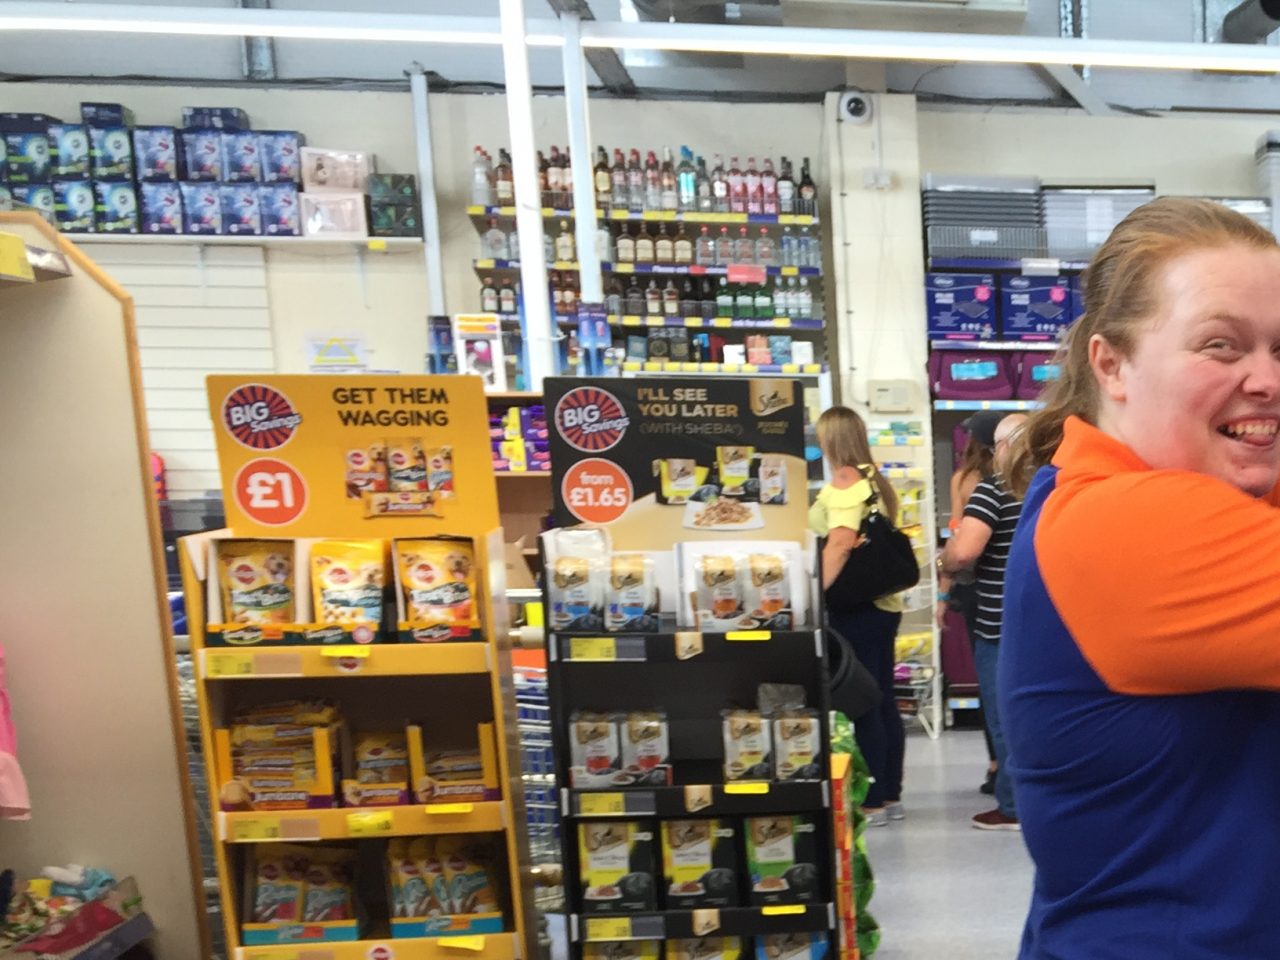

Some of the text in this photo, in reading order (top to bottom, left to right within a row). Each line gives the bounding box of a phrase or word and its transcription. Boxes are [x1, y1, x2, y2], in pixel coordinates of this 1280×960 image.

[332, 388, 448, 405] GET THEM
[638, 388, 707, 401] I'LL SEE
[230, 402, 269, 425] BIG
[338, 410, 448, 427] WAGGING
[564, 405, 600, 427] BIG
[639, 403, 738, 418] YOU LATER
[251, 414, 301, 432] Savings
[582, 417, 630, 435] Savings
[639, 422, 685, 435] (WITH
[580, 473, 613, 486] from
[246, 472, 294, 508] £1
[570, 488, 627, 507] £1.65
